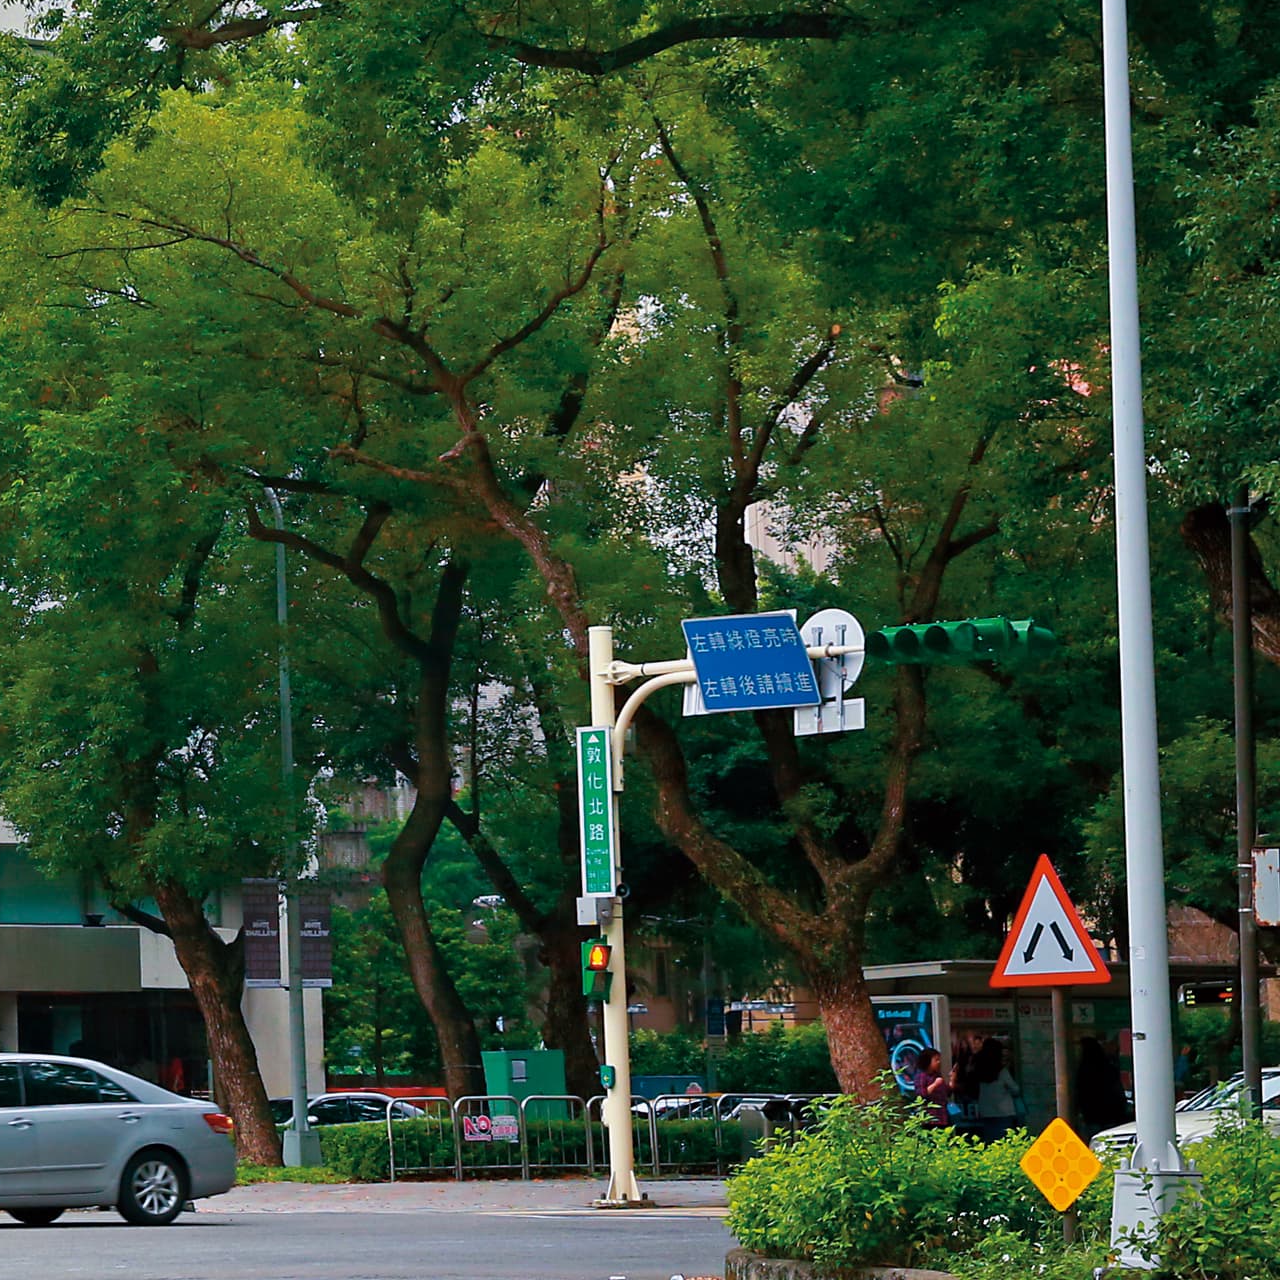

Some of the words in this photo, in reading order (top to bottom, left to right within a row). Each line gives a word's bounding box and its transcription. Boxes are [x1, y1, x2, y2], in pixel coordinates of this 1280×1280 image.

[691, 629, 798, 653] 左轉綠燈亮時
[704, 673, 814, 698] 左轉後請續進
[587, 747, 604, 841] 敦化北路
